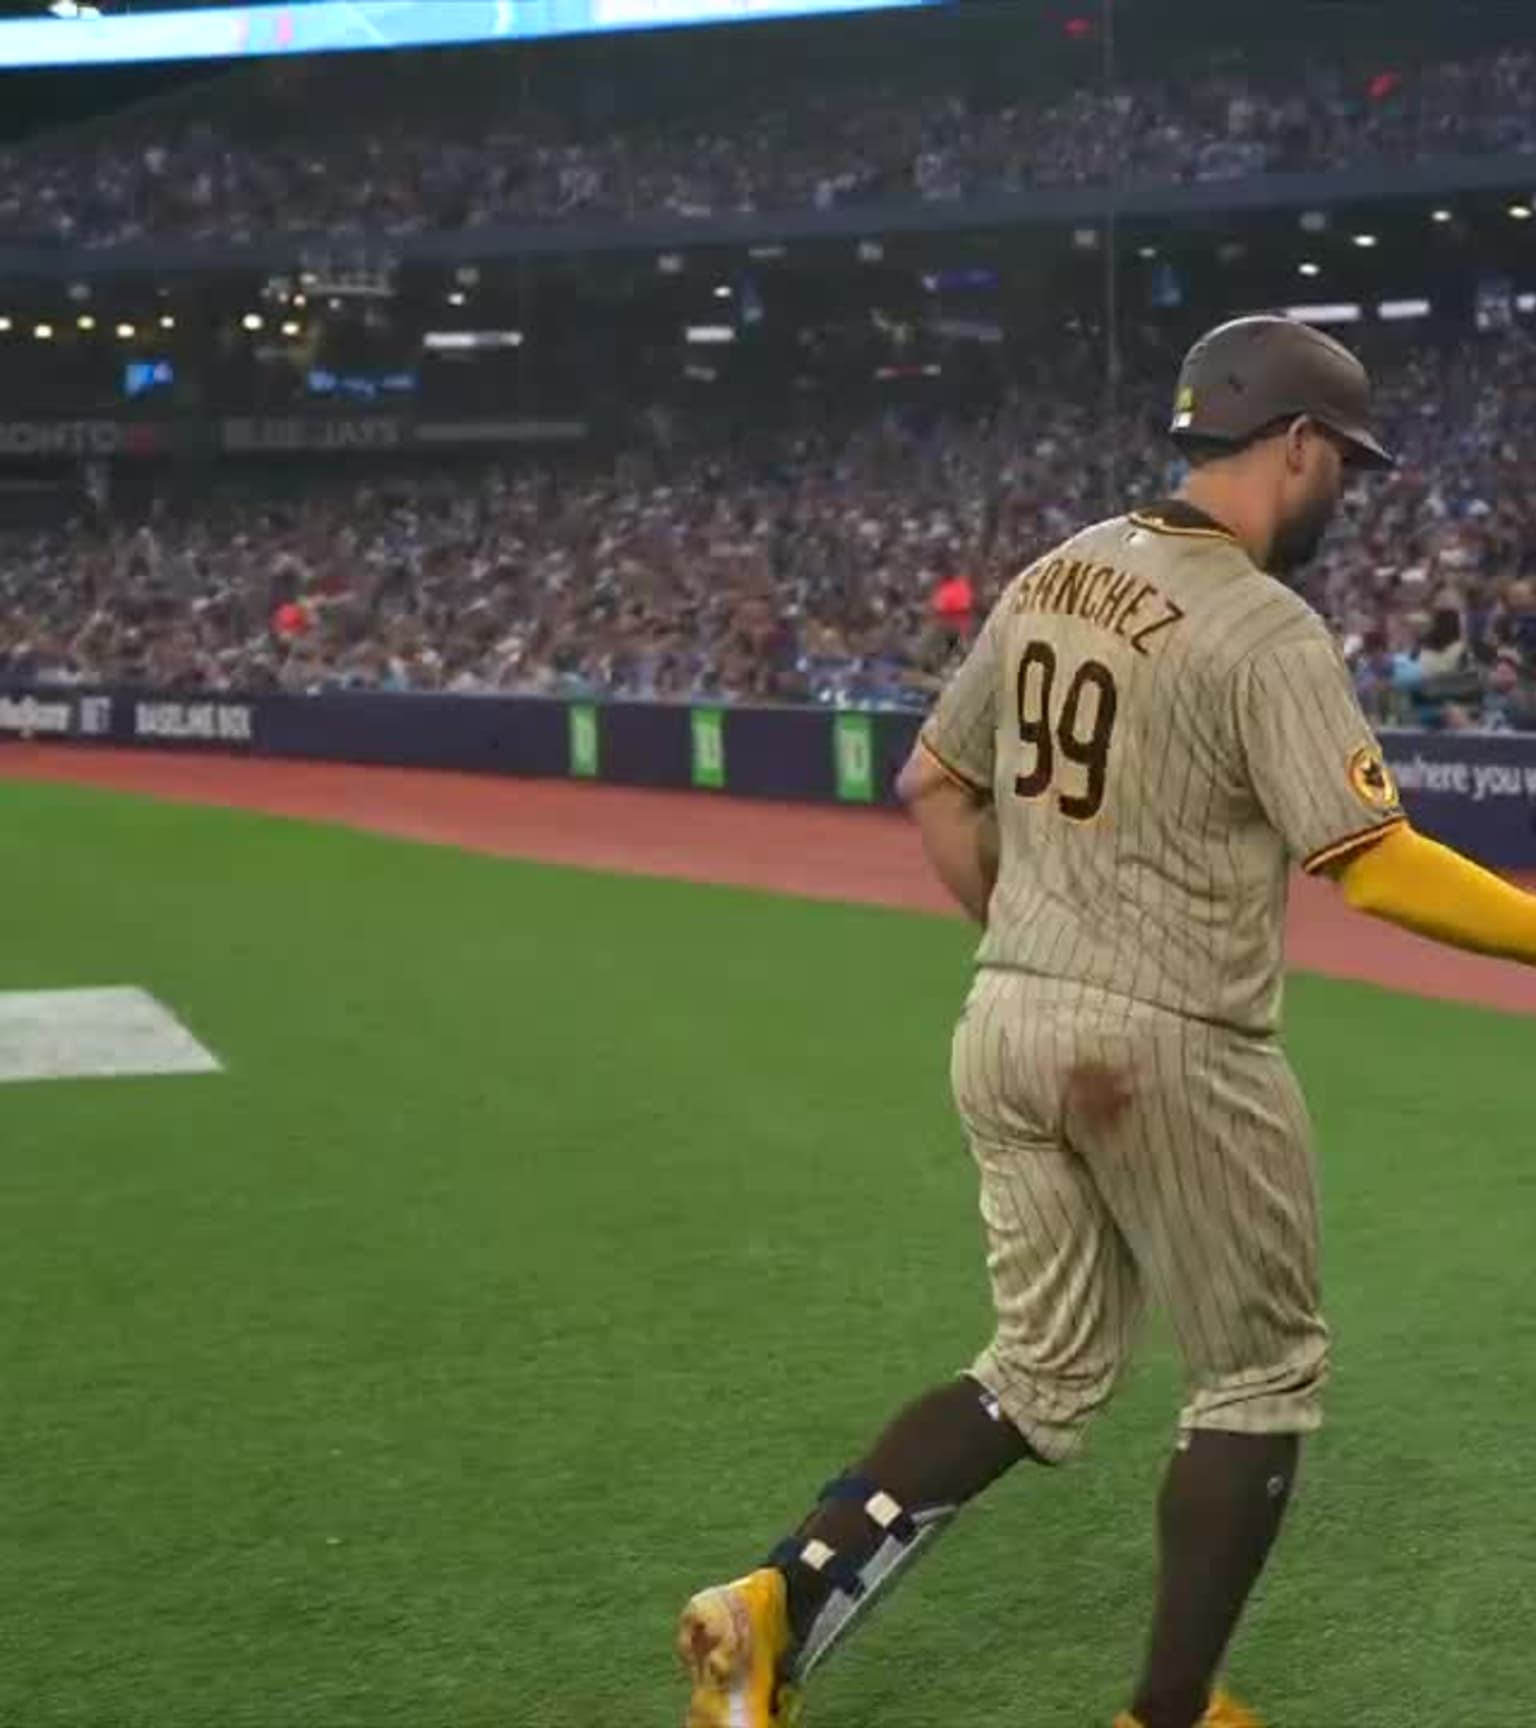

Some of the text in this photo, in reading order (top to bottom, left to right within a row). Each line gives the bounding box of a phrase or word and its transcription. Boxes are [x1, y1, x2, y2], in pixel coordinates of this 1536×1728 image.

[1013, 557, 1185, 657] SANCHEZ
[1013, 639, 1118, 822] 99
[1472, 766, 1521, 800] you
